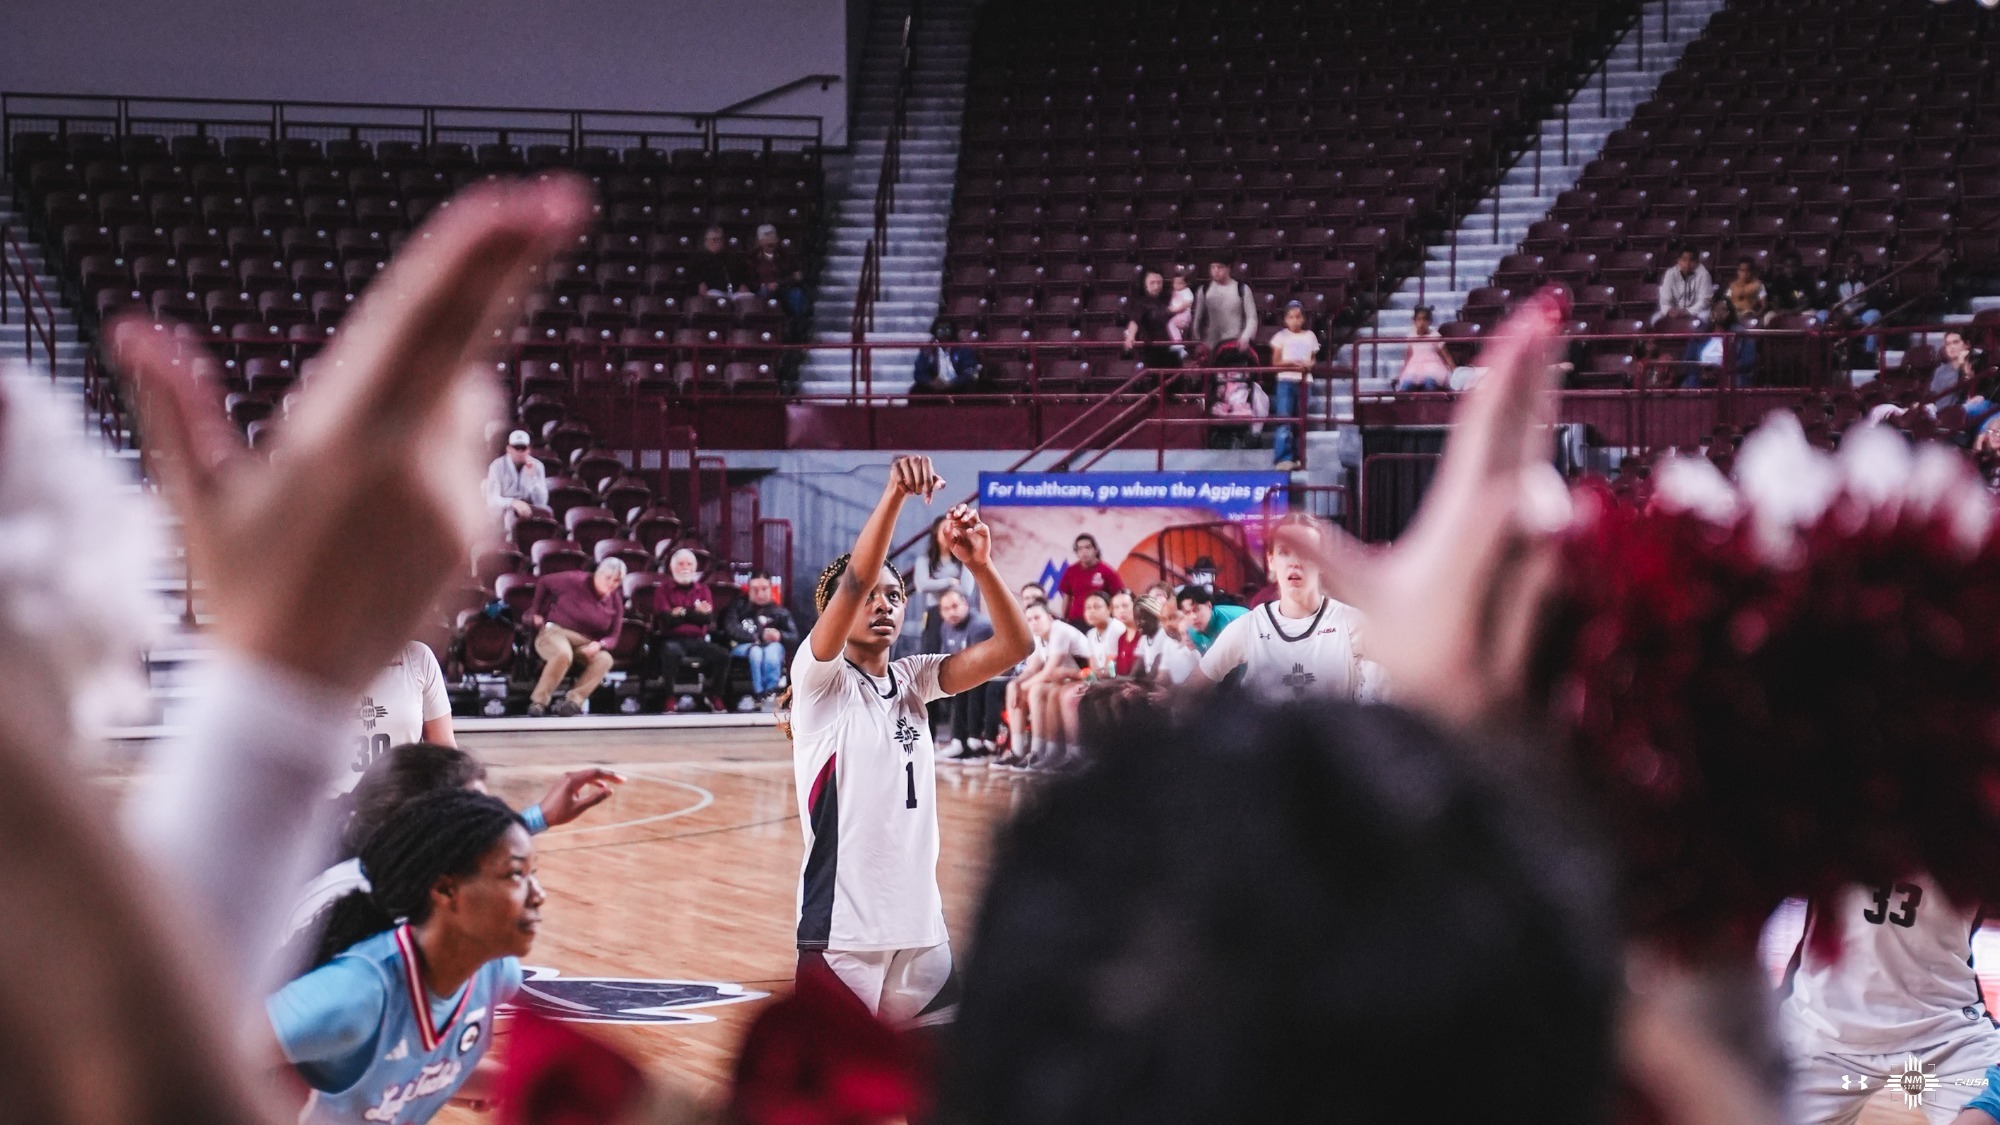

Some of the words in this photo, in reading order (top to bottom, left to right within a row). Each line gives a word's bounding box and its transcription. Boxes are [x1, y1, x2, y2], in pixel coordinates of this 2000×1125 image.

[987, 481, 1014, 497] For
[1015, 480, 1094, 499] healthcare,
[1097, 485, 1119, 502] go
[1120, 481, 1168, 498] where
[1169, 481, 1197, 498] the
[1197, 482, 1251, 503] Aggies
[351, 733, 391, 772] 30
[906, 761, 917, 809] 1
[1863, 882, 1923, 928] 33
